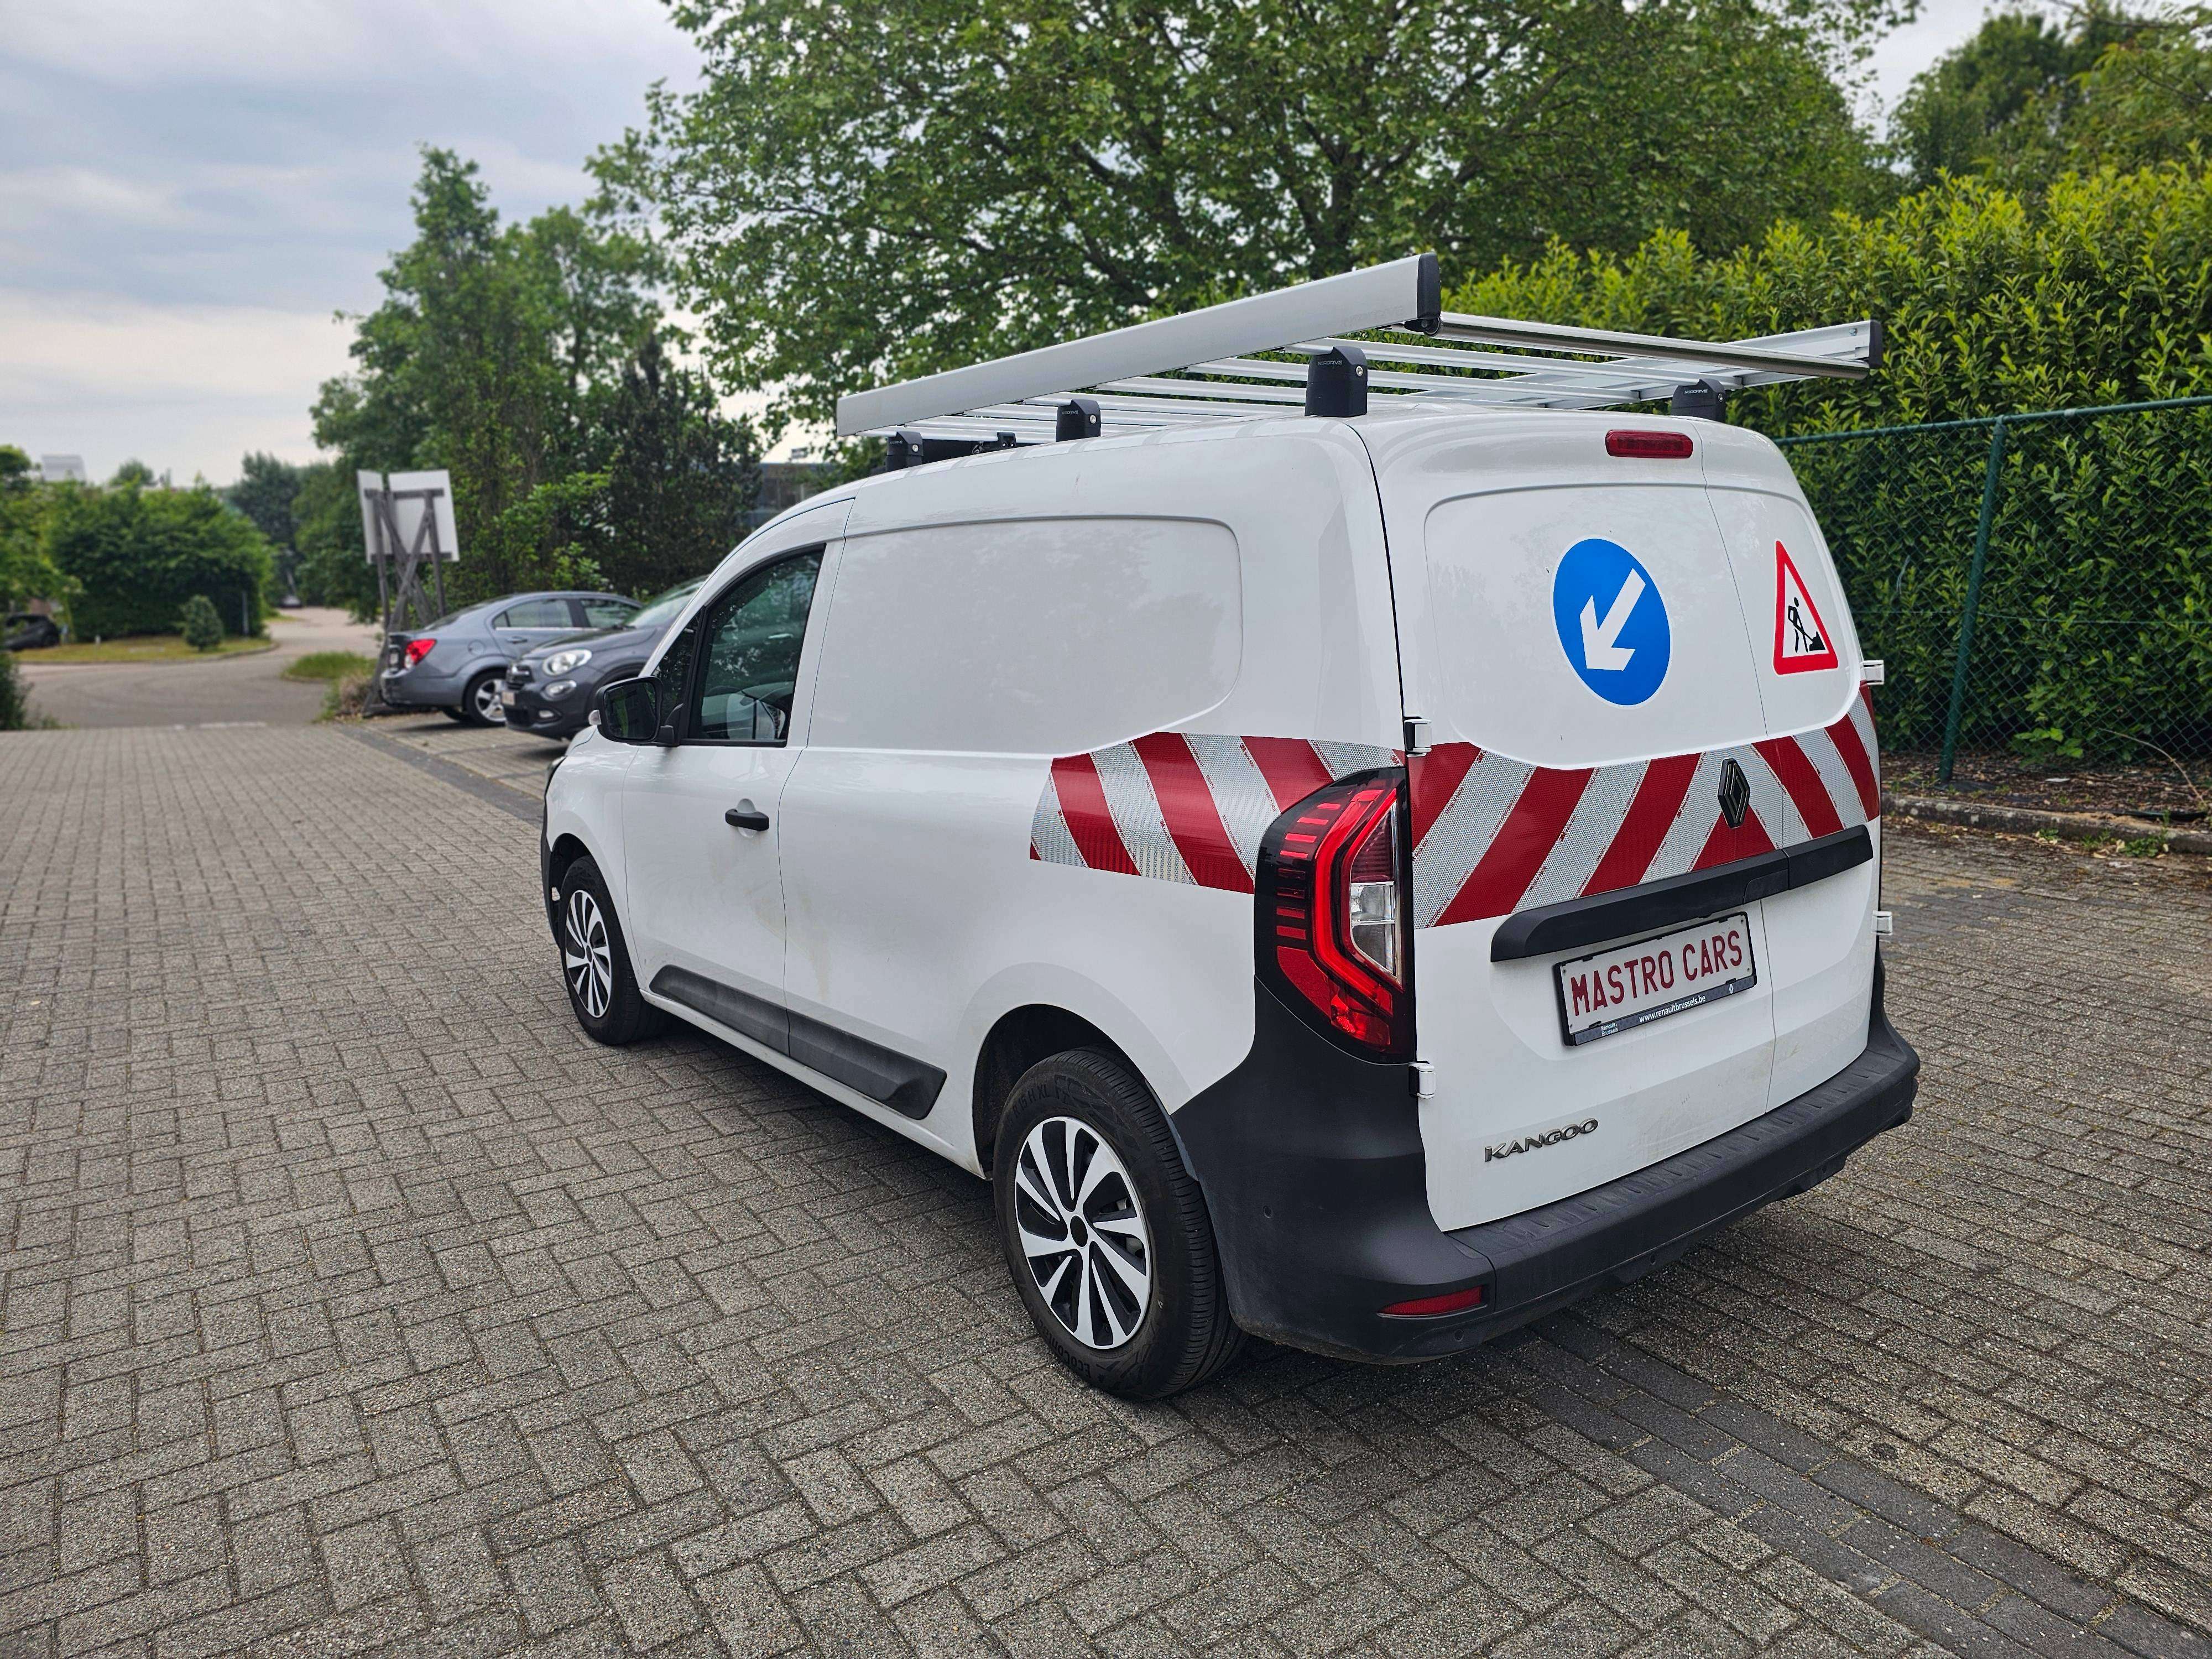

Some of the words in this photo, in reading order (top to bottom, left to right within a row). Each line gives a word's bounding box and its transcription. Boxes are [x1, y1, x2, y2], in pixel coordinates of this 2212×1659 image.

[1571, 951, 1674, 1016] MASTRO
[1682, 930, 1743, 980] CARS
[1639, 995, 1706, 1022] www.renaultbrussels.be
[1484, 1118, 1599, 1162] KANGOO
